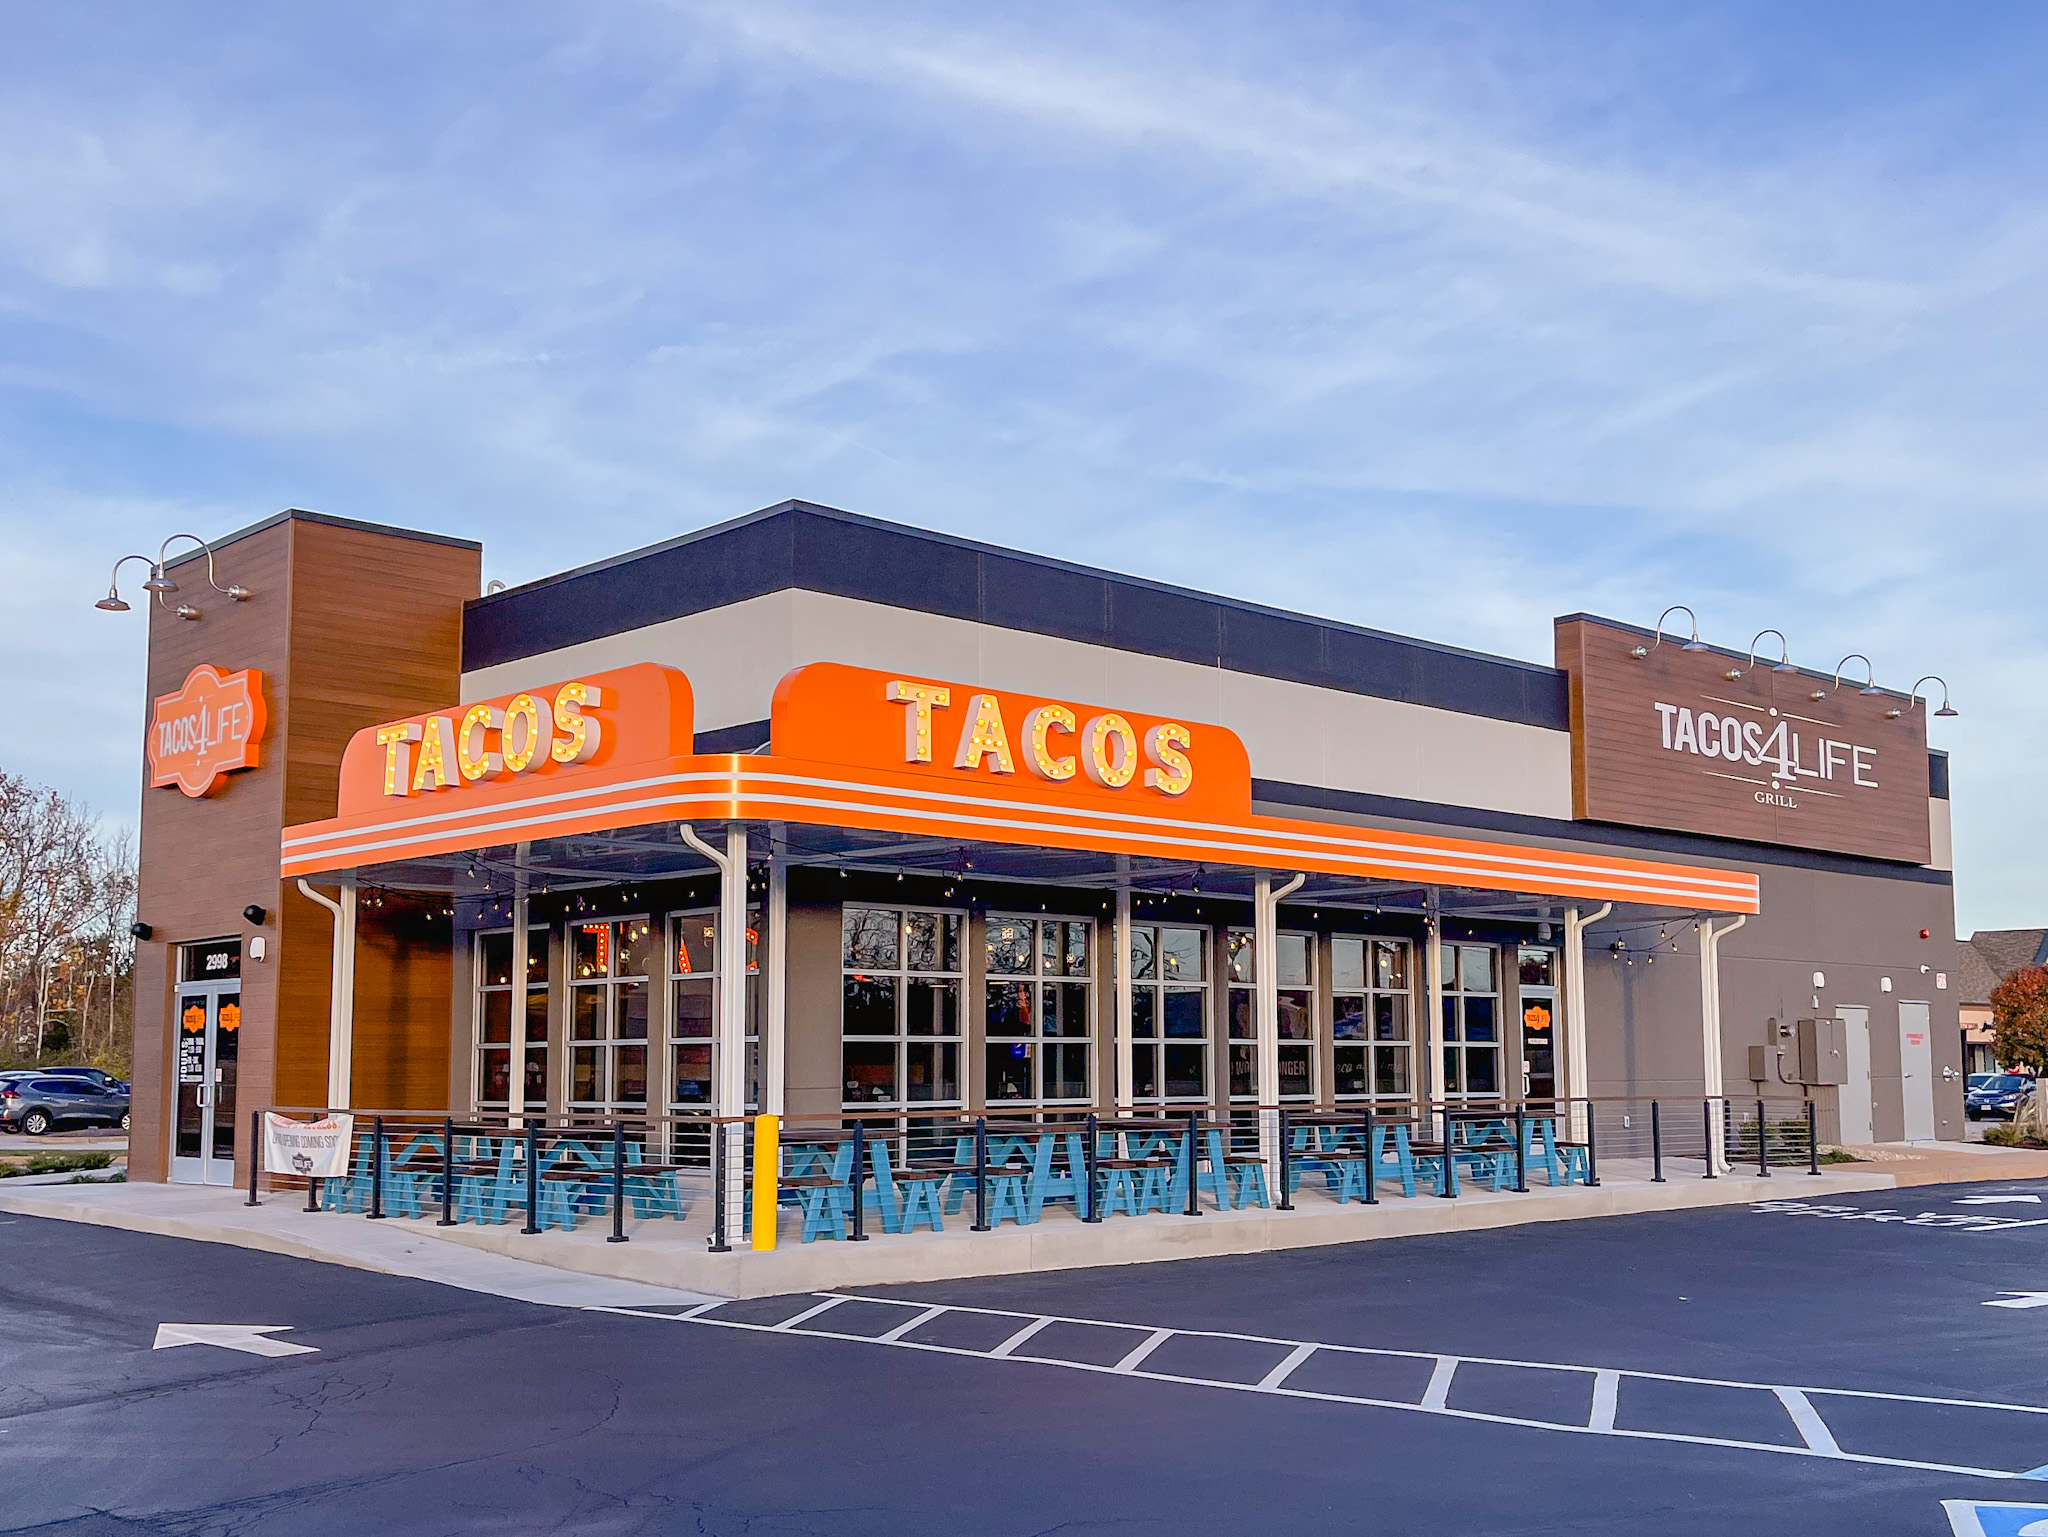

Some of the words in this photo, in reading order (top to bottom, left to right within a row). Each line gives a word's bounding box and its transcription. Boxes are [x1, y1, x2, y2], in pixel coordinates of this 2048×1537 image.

[376, 682, 602, 796] TACOS
[886, 680, 1193, 795] TACOS
[1754, 791, 1798, 809] GRILL
[205, 952, 229, 971] 2998
